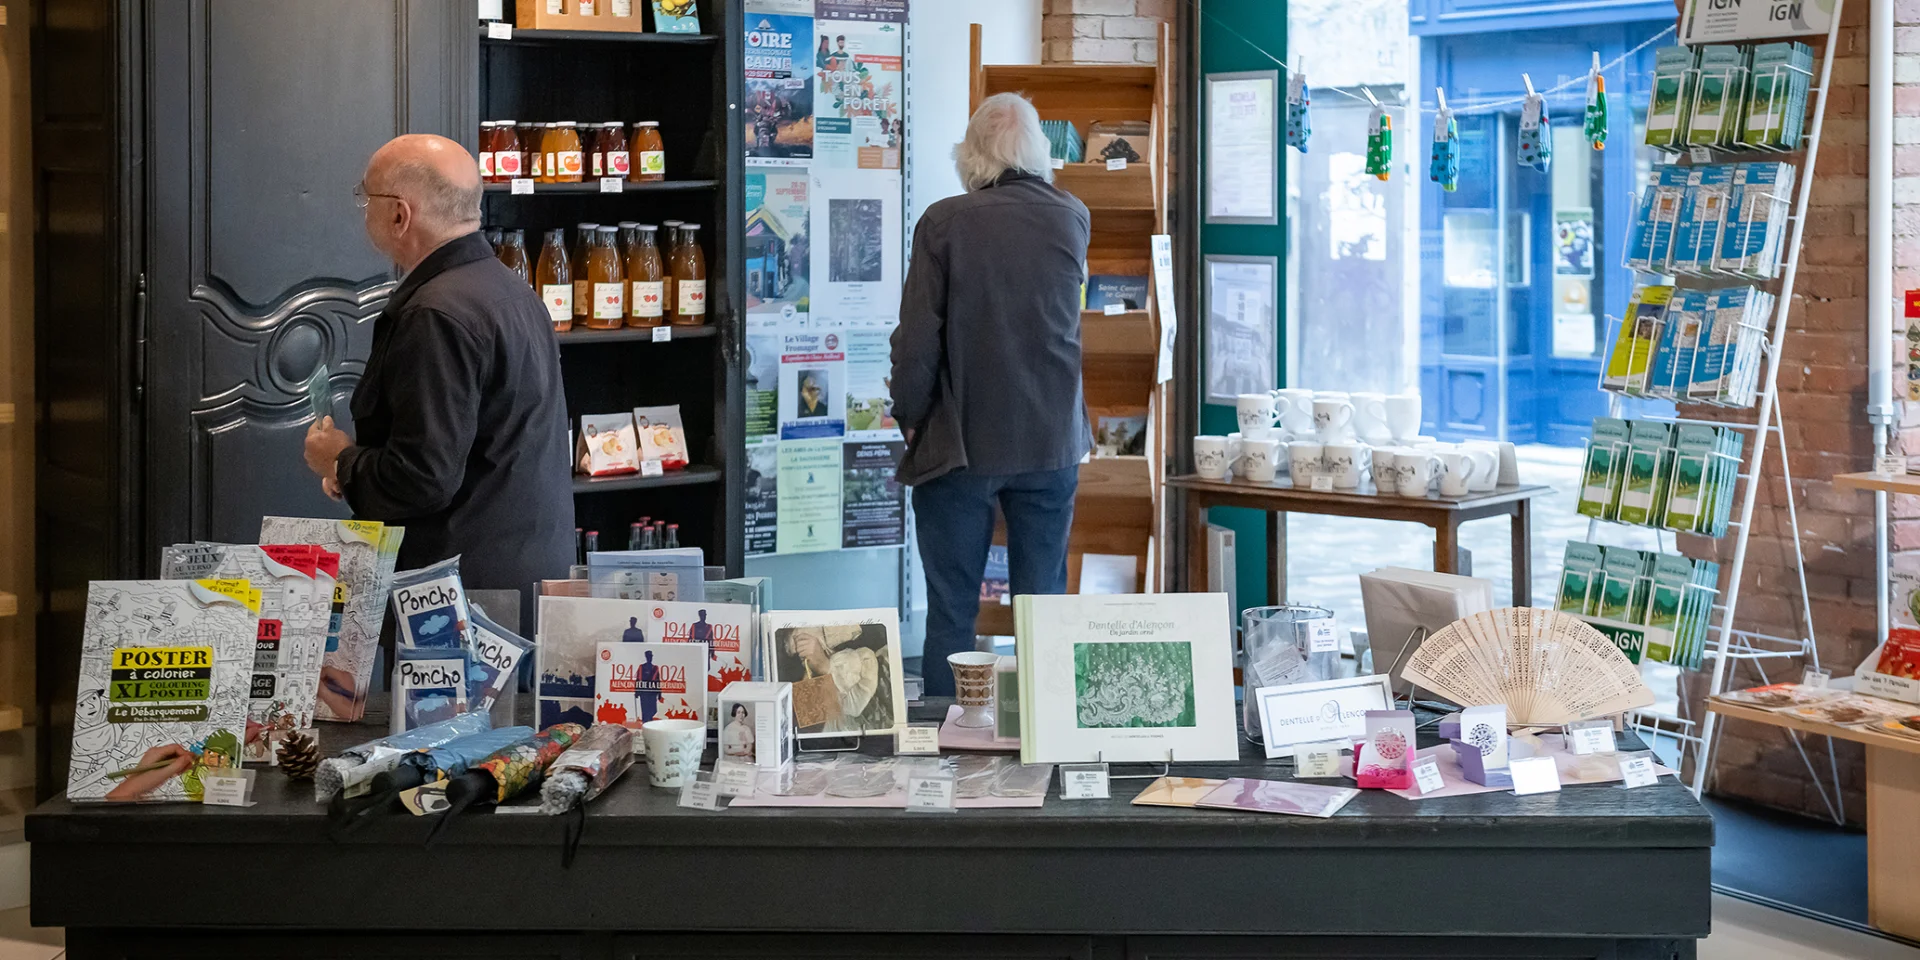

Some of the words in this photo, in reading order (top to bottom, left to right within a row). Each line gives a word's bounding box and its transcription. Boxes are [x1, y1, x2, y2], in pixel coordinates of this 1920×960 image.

[1769, 3, 1802, 21] IGN
[823, 70, 861, 84] TOUS
[843, 85, 861, 97] EN
[843, 96, 889, 110] FORÊT
[795, 335, 819, 343] Village
[187, 553, 220, 564] JEUX
[398, 585, 458, 614] Poncho
[1088, 621, 1127, 630] Dentelle
[1129, 620, 1175, 631] d'Alençon
[1613, 631, 1642, 652] IGN
[120, 651, 207, 666] POSTER
[130, 668, 138, 679] à
[144, 668, 196, 678] colorier
[401, 663, 461, 692] Poncho
[116, 683, 148, 698] XL
[611, 681, 635, 689] ALENÇON
[657, 681, 686, 689] LIBÉRATION
[149, 689, 203, 698] POSTER
[131, 706, 202, 717] Débarquement
[1280, 716, 1314, 726] DENTELLE
